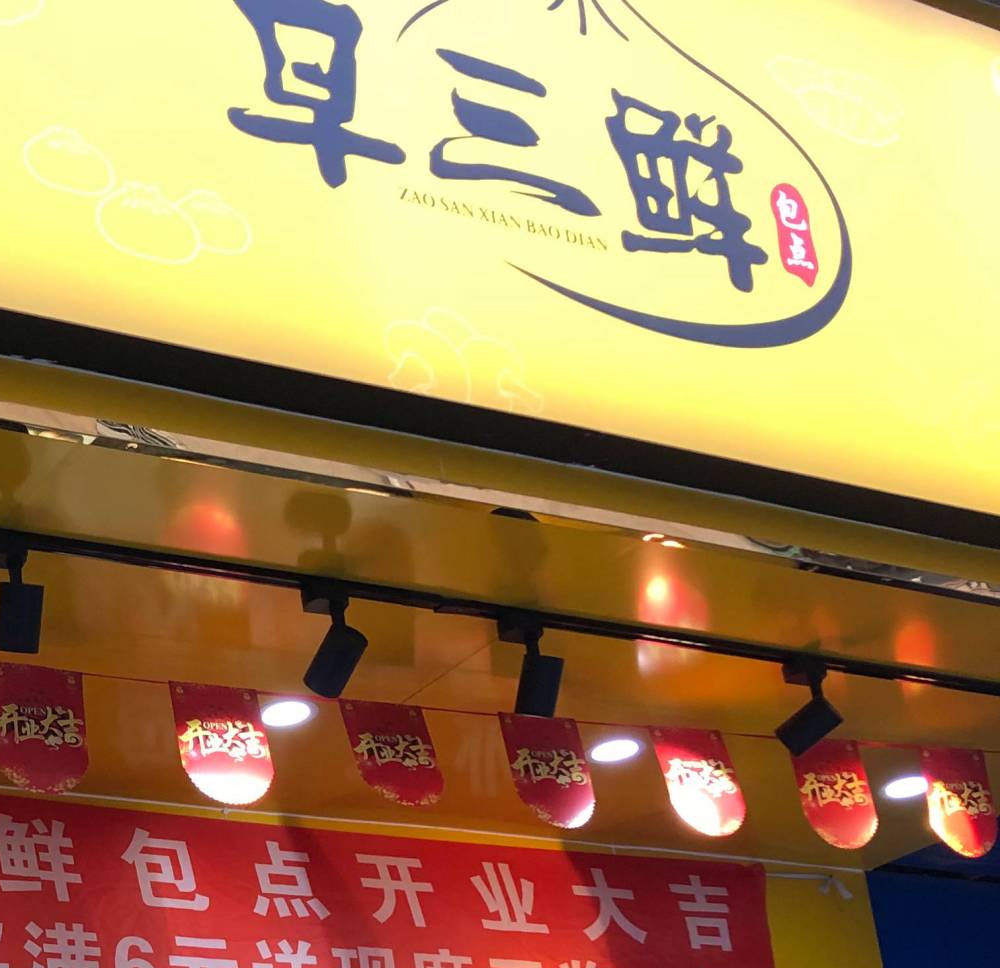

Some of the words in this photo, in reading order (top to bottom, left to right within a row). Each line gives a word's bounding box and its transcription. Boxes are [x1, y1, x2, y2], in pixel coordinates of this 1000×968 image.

[227, 0, 768, 292] 早三鲜
[400, 187, 435, 208] ZAO
[440, 197, 474, 217] SAN
[479, 207, 521, 228] XIAN
[526, 219, 561, 239] BAO
[565, 229, 608, 251] DIAN
[776, 190, 815, 270] 包点
[19, 705, 47, 716] OPEN
[203, 720, 227, 731] OPEN
[178, 719, 265, 760] 开业大吉
[354, 732, 435, 769] 开业大吉
